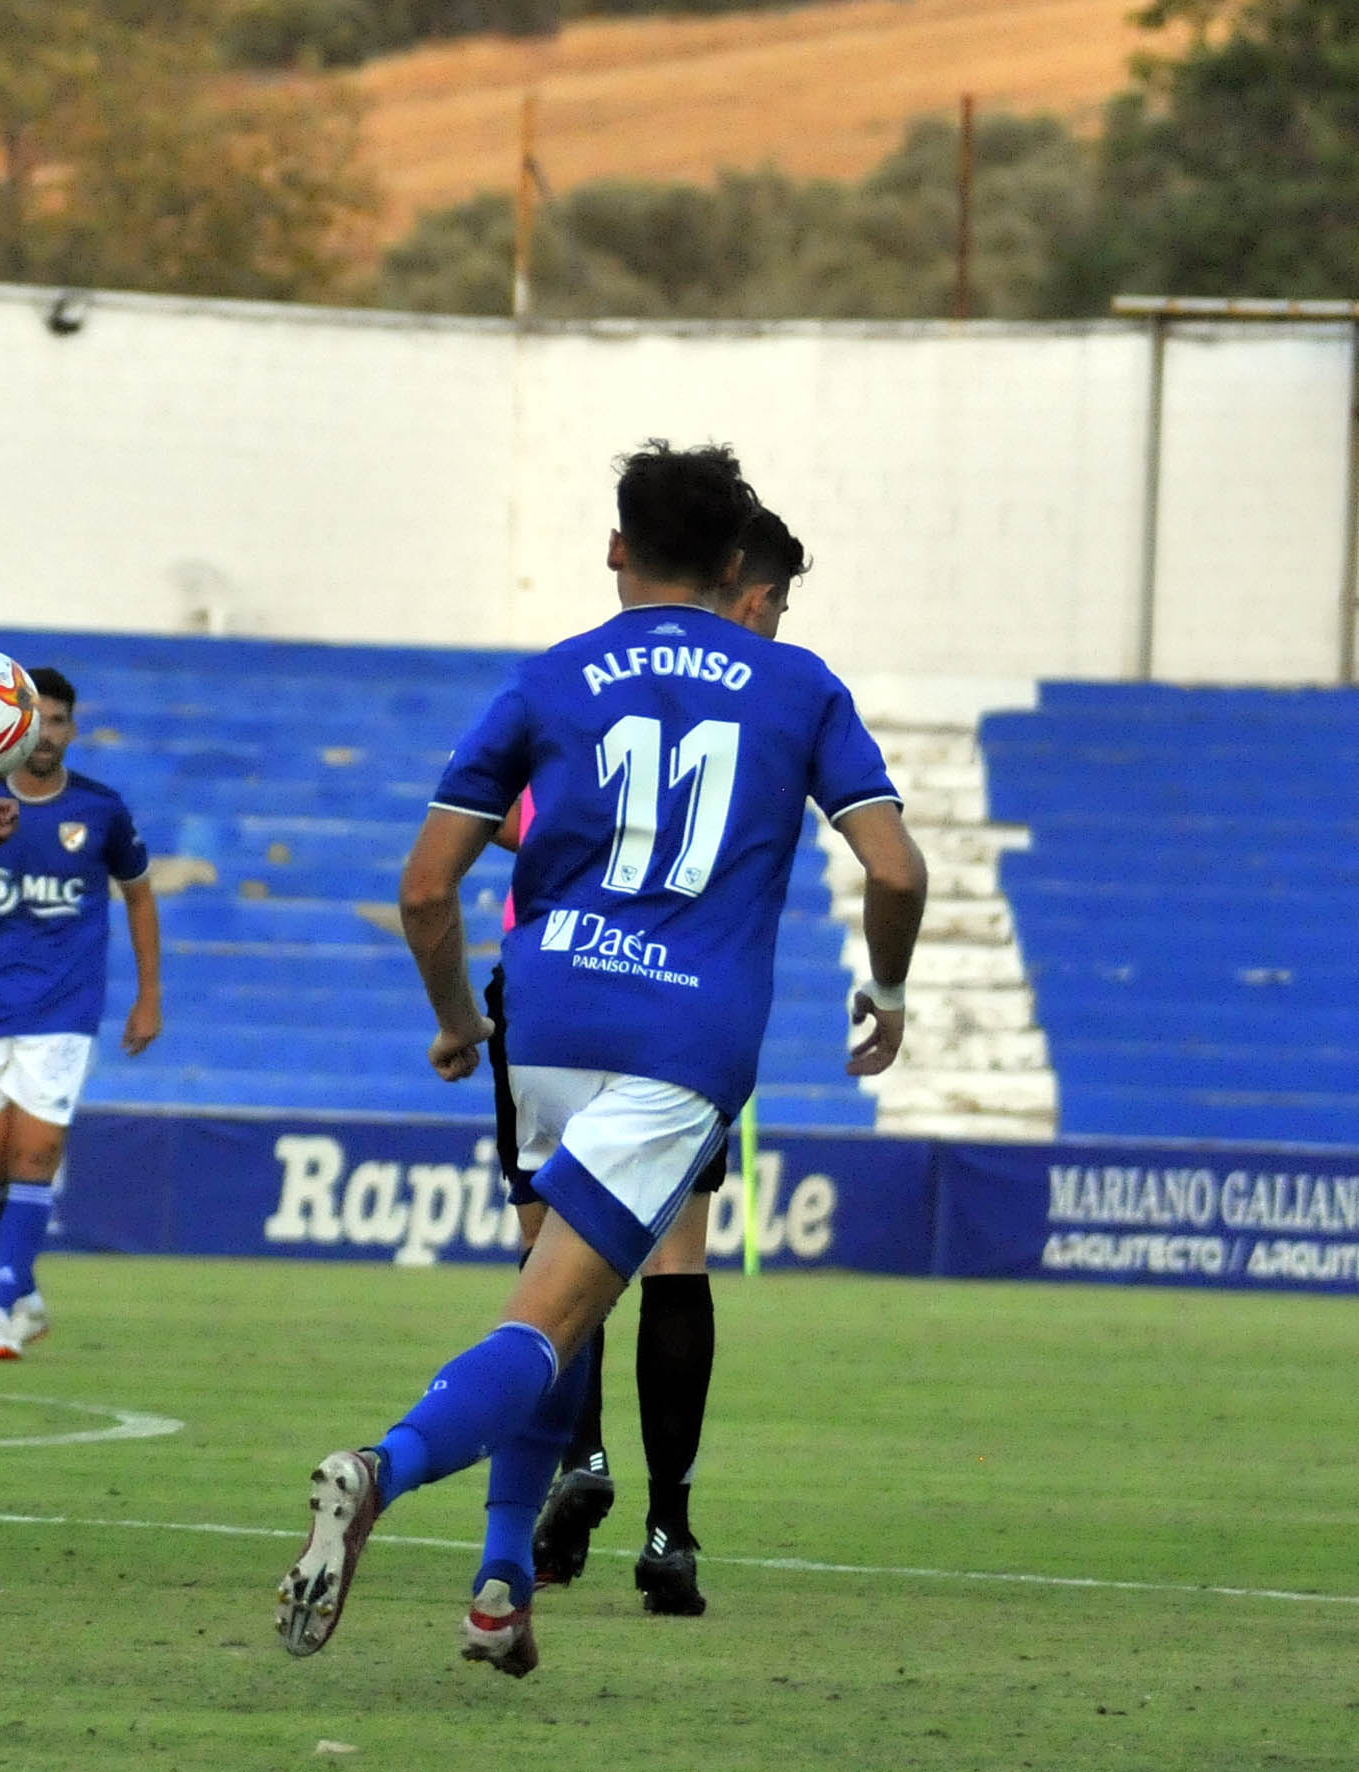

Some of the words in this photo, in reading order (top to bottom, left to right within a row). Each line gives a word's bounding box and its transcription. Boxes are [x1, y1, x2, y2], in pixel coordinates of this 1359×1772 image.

[583, 645, 752, 697] ALFONSO
[595, 715, 741, 898] 11
[22, 873, 85, 904] MLC
[574, 913, 668, 968] Jaén
[572, 954, 630, 974] PARAÍSO
[631, 962, 700, 988] INTERIOR
[1046, 1165, 1217, 1228] MARIANO
